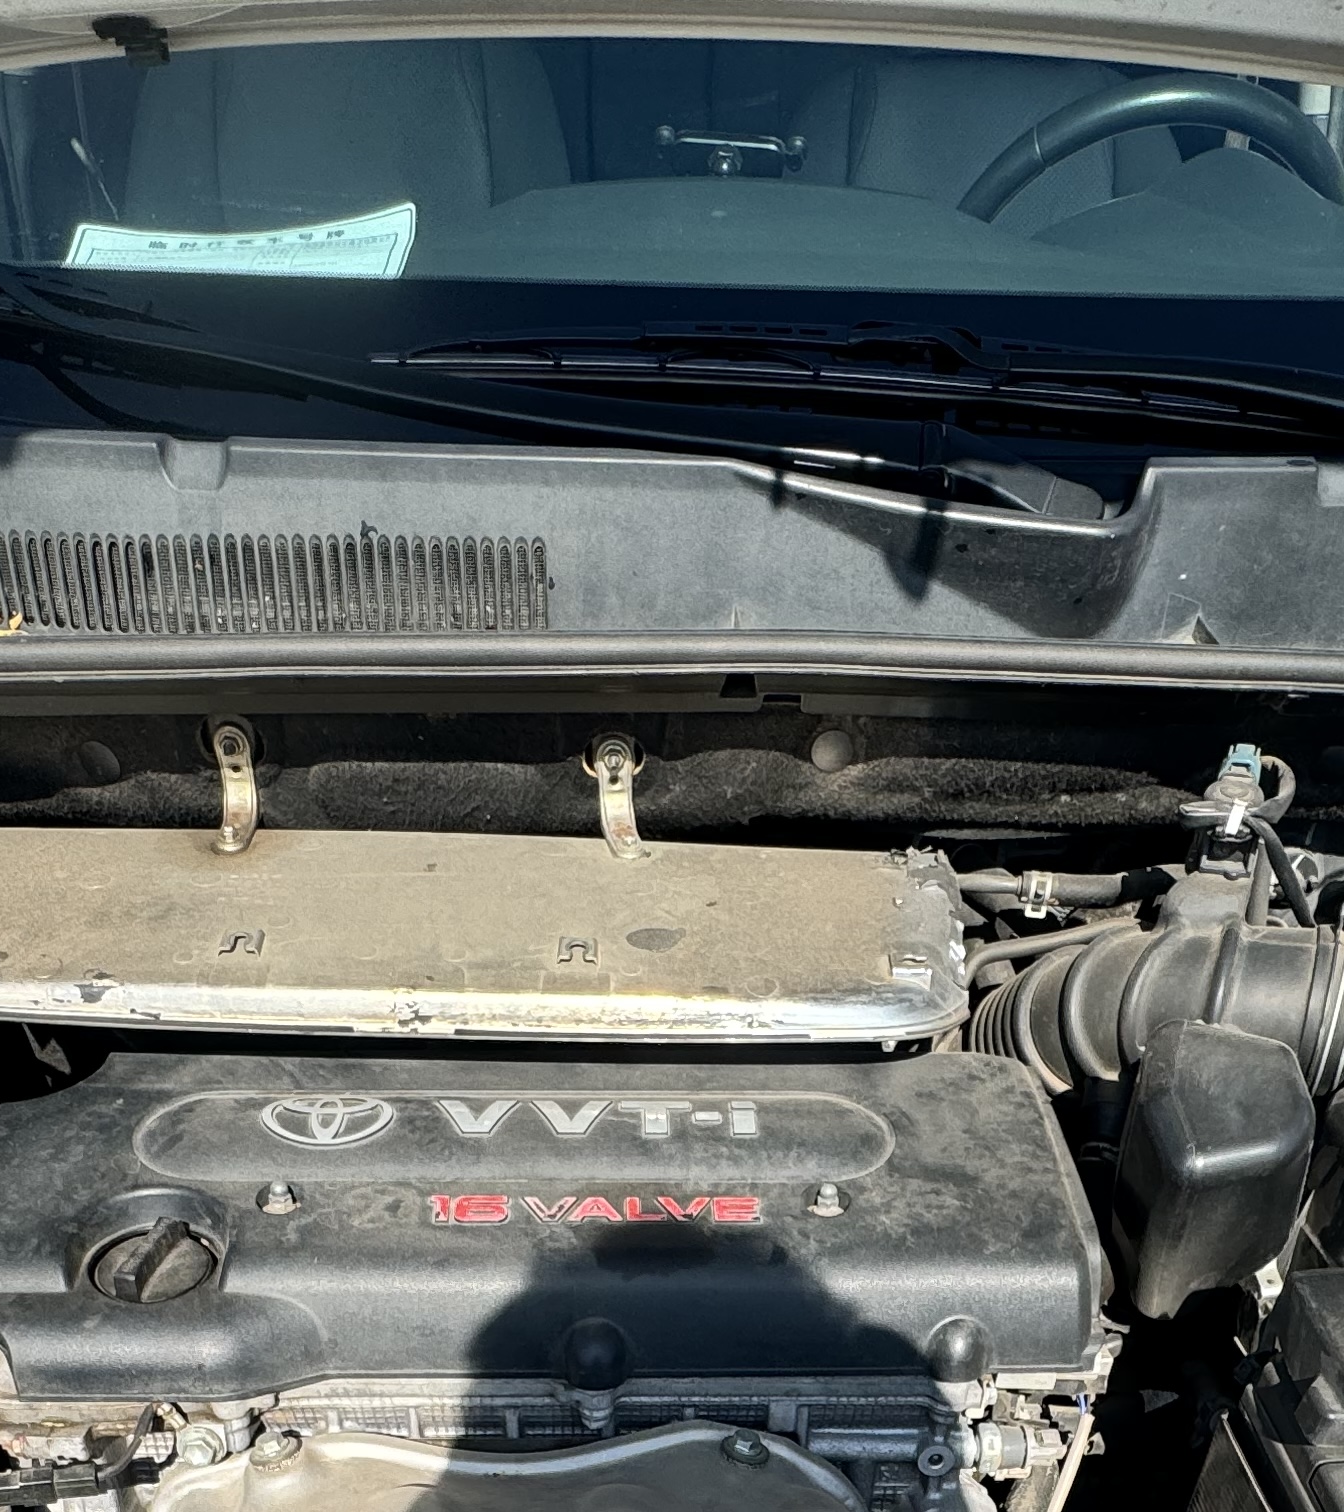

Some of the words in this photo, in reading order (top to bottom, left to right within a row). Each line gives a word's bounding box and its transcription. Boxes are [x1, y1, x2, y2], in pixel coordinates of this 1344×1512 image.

[438, 1099, 759, 1138] VVT-i
[430, 1194, 511, 1224] 16
[519, 1195, 765, 1225] VALVE
